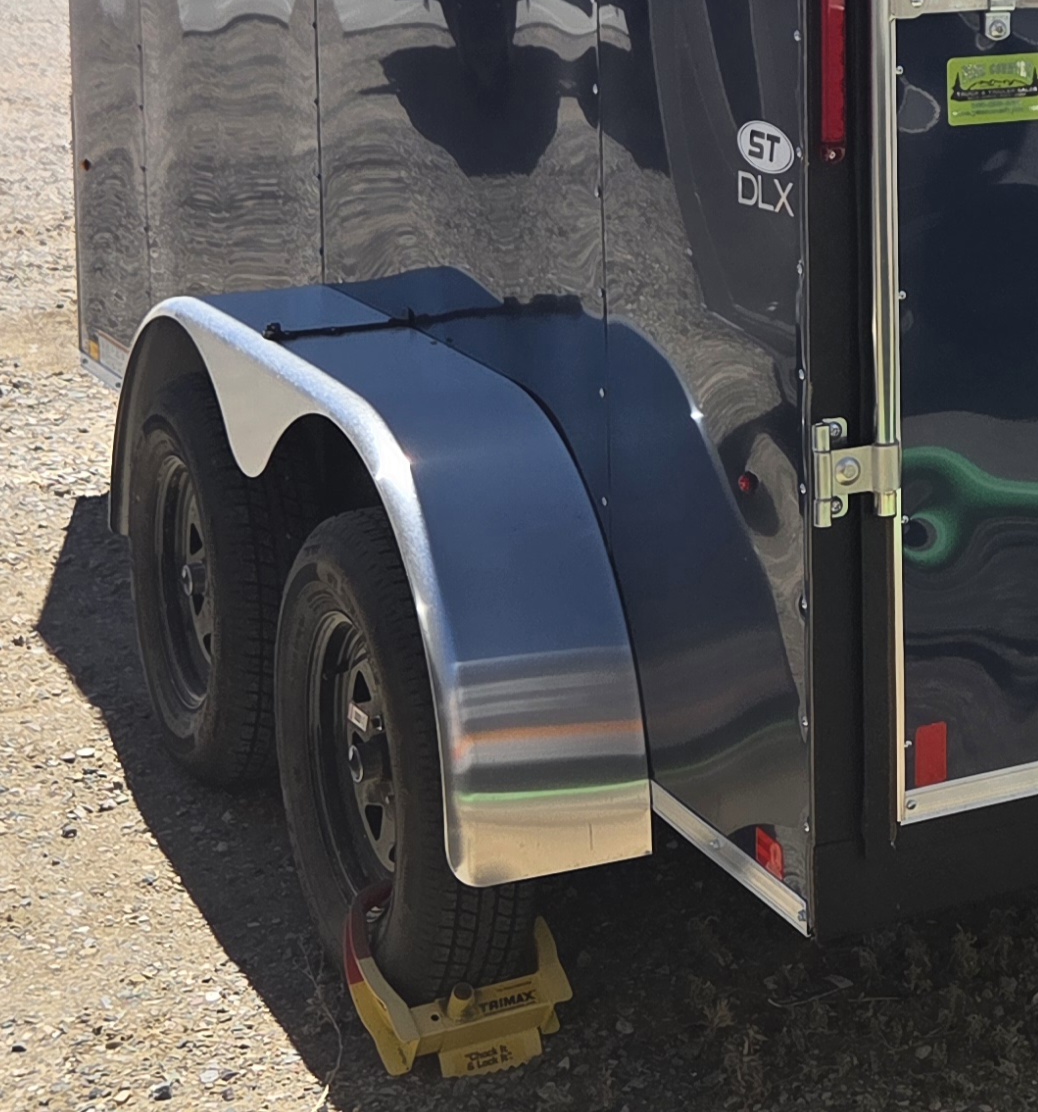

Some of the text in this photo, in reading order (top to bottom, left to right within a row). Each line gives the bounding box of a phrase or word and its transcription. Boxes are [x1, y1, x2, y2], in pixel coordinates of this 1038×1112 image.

[748, 129, 781, 163] ST
[738, 170, 795, 218] DLX
[478, 990, 536, 1012] TRIMAX
[477, 1056, 499, 1069] Lock
